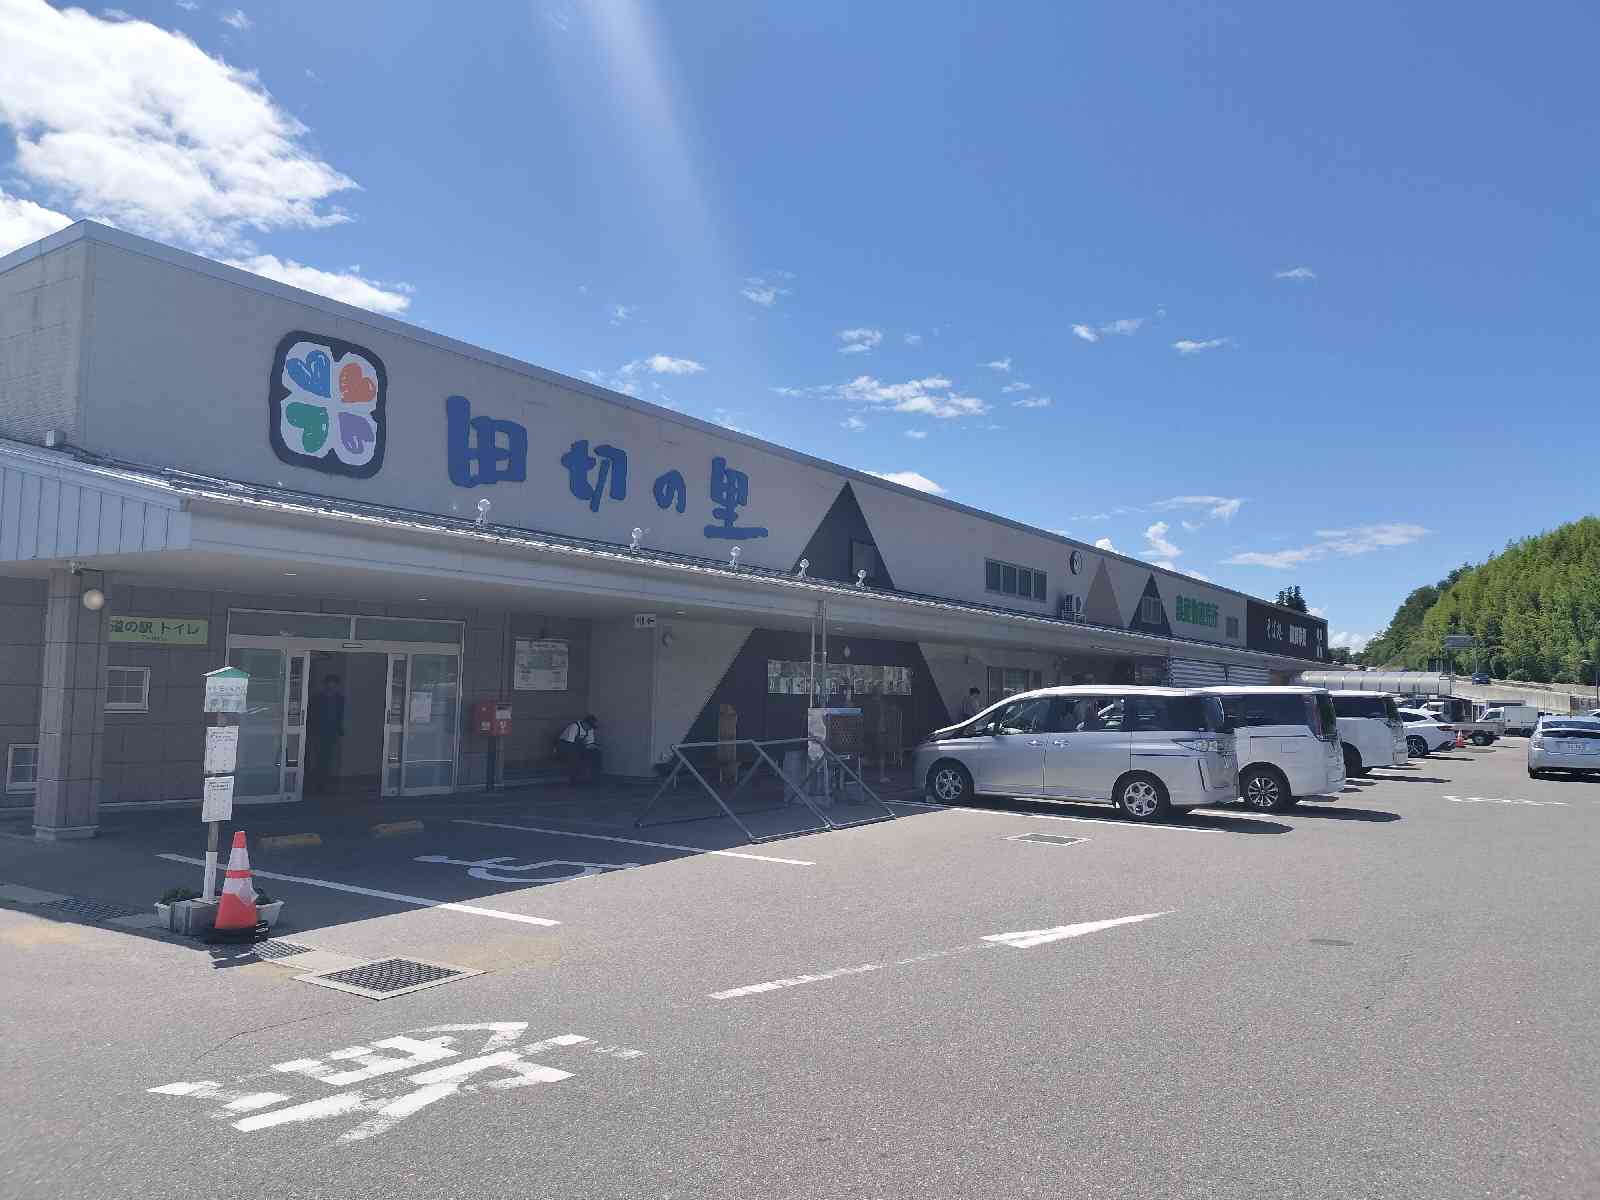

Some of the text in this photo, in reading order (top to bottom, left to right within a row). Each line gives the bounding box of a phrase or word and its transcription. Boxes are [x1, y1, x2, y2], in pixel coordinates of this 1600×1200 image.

[446, 395, 768, 540] 田切の里
[161, 621, 200, 636] トイレ
